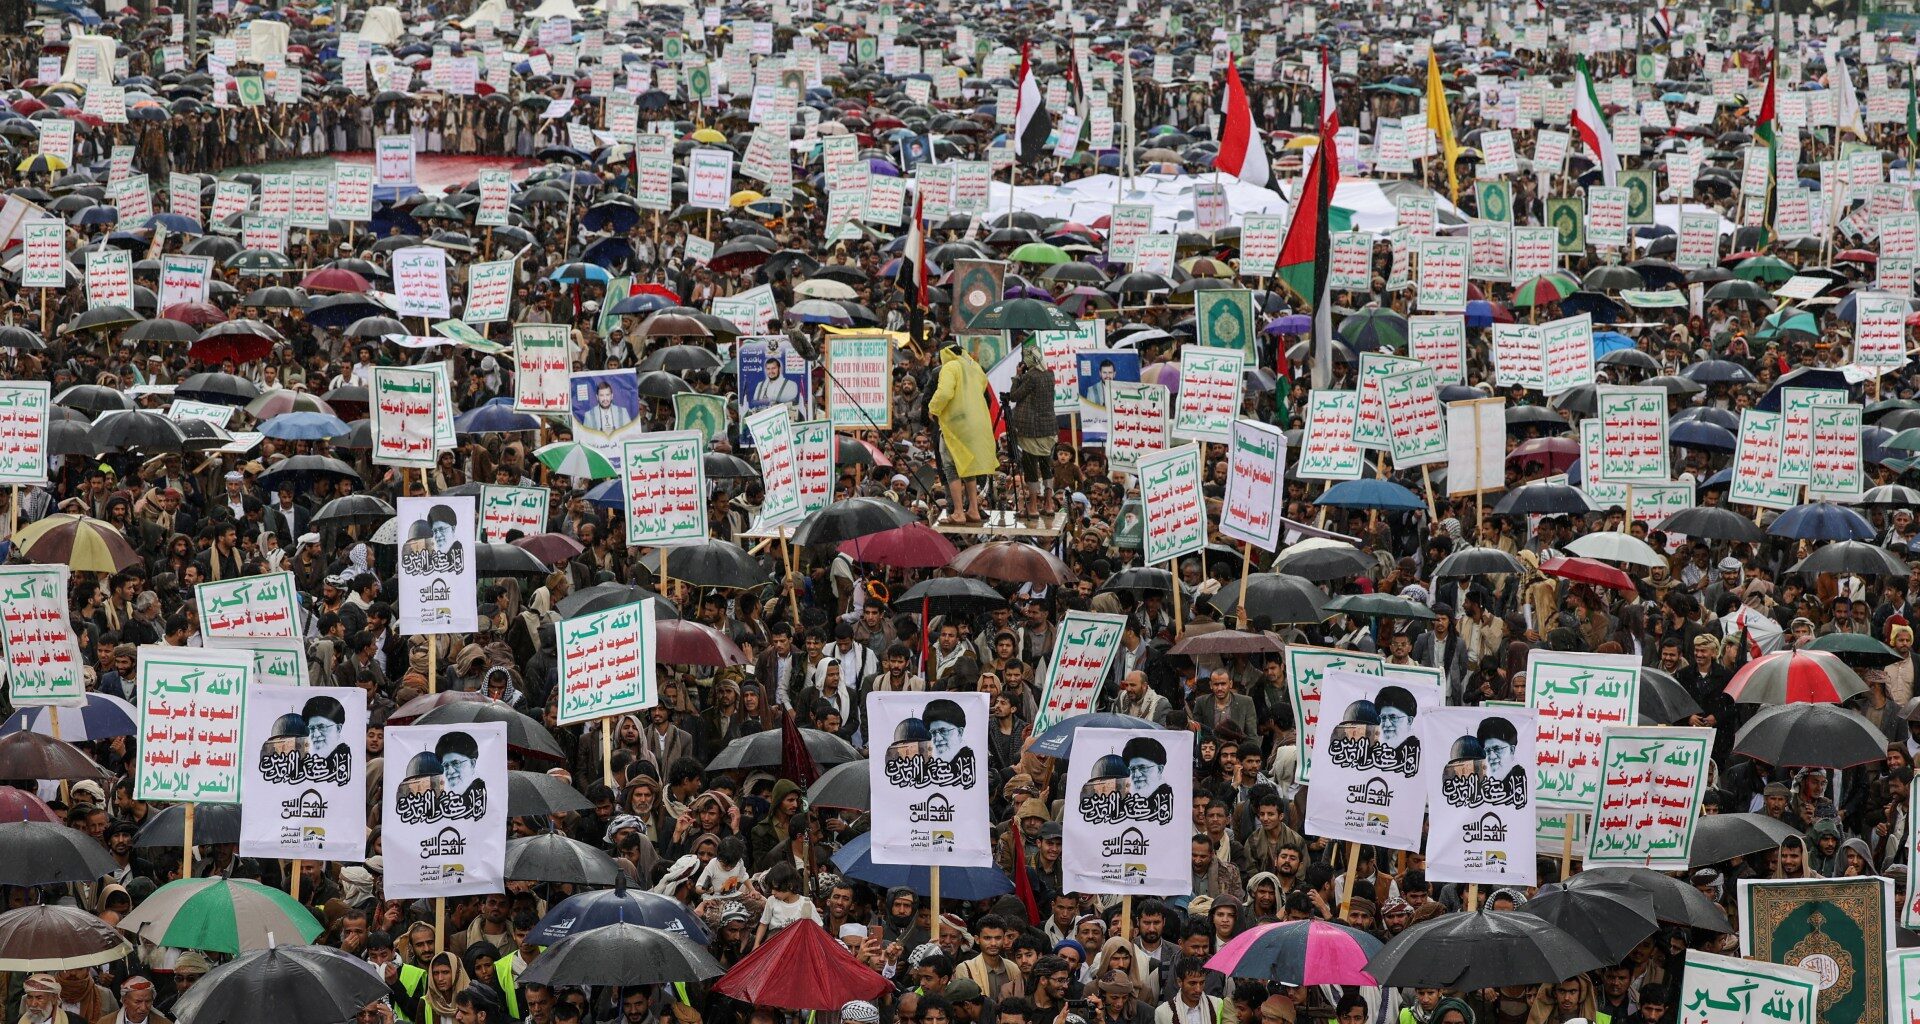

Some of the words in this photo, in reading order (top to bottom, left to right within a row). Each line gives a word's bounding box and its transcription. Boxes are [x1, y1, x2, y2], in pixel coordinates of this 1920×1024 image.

[833, 362, 851, 373] DEATH
[853, 362, 859, 373] TO
[861, 362, 884, 373] AMERICA
[379, 375, 431, 393] قاطعوا
[853, 377, 859, 387] TO
[860, 377, 880, 387] ISRAEL
[381, 399, 405, 414] الأمريكية
[406, 402, 431, 416] البضائع
[381, 435, 431, 453] الإسرائيلية
[671, 445, 694, 460] الله
[629, 444, 668, 468] أكبر
[630, 466, 665, 482] لأمريكا
[668, 467, 696, 480] الموت
[632, 485, 665, 500] لإسرائيل
[669, 484, 696, 497] الموت
[633, 503, 656, 517] اليهود
[660, 502, 672, 514] على
[677, 500, 698, 511] اللعنة
[634, 518, 666, 537] للإسلام
[670, 515, 699, 534] النصر
[207, 582, 252, 613] أكبر
[257, 581, 285, 601] الله
[210, 608, 251, 629] لأمريكا
[255, 607, 289, 624] الموت
[611, 610, 637, 628] الله
[566, 614, 608, 645] أكبر
[607, 631, 638, 649] الموت
[11, 650, 35, 666] اليهود
[38, 650, 50, 665] على
[566, 639, 604, 660] لأمريكا
[608, 649, 638, 667] الموت
[567, 657, 604, 679] لإسرائيل
[616, 666, 639, 681] اللعنة
[16, 670, 45, 693] للإسلام
[49, 668, 77, 691] النصر
[149, 668, 204, 698] أكبر
[207, 673, 240, 695] الله
[566, 677, 593, 693] اليهود
[597, 674, 611, 688] على
[566, 691, 602, 711] للإسلام
[606, 682, 639, 705] النصر
[148, 698, 195, 719] لأمريكا
[200, 706, 238, 721] الموت
[147, 725, 194, 745] لإسرائيل
[198, 730, 236, 745] الموت
[145, 750, 178, 766] اليهود
[183, 751, 201, 768] على
[206, 751, 235, 766] اللعنة
[1608, 741, 1664, 769] أكبر
[1664, 745, 1698, 766] الله
[142, 771, 190, 799] للإسلام
[193, 772, 234, 797] النصر
[1607, 768, 1652, 787] لأمريكا
[1655, 774, 1694, 788] الموت
[1603, 791, 1648, 809] لإسرائيل
[1652, 794, 1691, 808] الموت
[1600, 814, 1632, 830] اليهود
[1636, 814, 1653, 829] على
[1658, 812, 1686, 828] اللعنة
[1596, 833, 1641, 855] للإسلام
[1643, 829, 1683, 853] النصر
[1684, 978, 1759, 1017] أكبر
[1761, 989, 1804, 1023] الله
